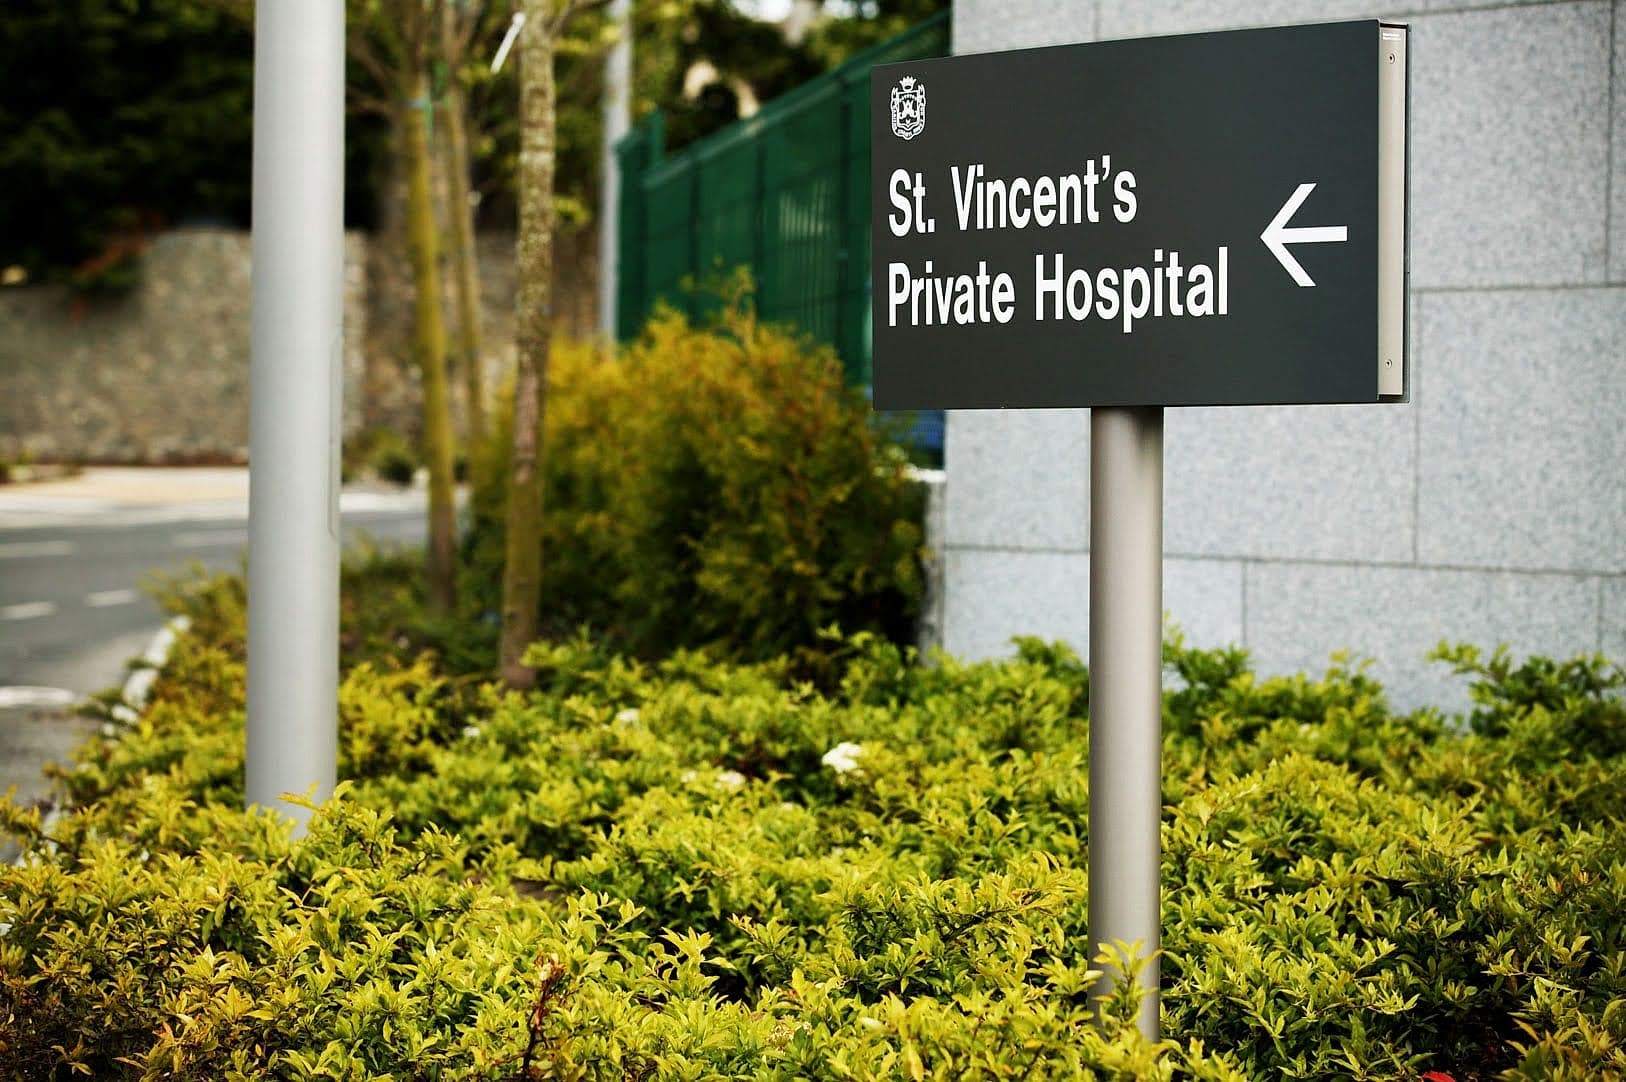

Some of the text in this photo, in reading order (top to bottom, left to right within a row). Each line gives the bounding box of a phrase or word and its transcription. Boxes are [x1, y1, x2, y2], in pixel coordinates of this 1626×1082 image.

[888, 154, 1138, 237] St. Vincent's
[888, 246, 1228, 334] Private Hospital
